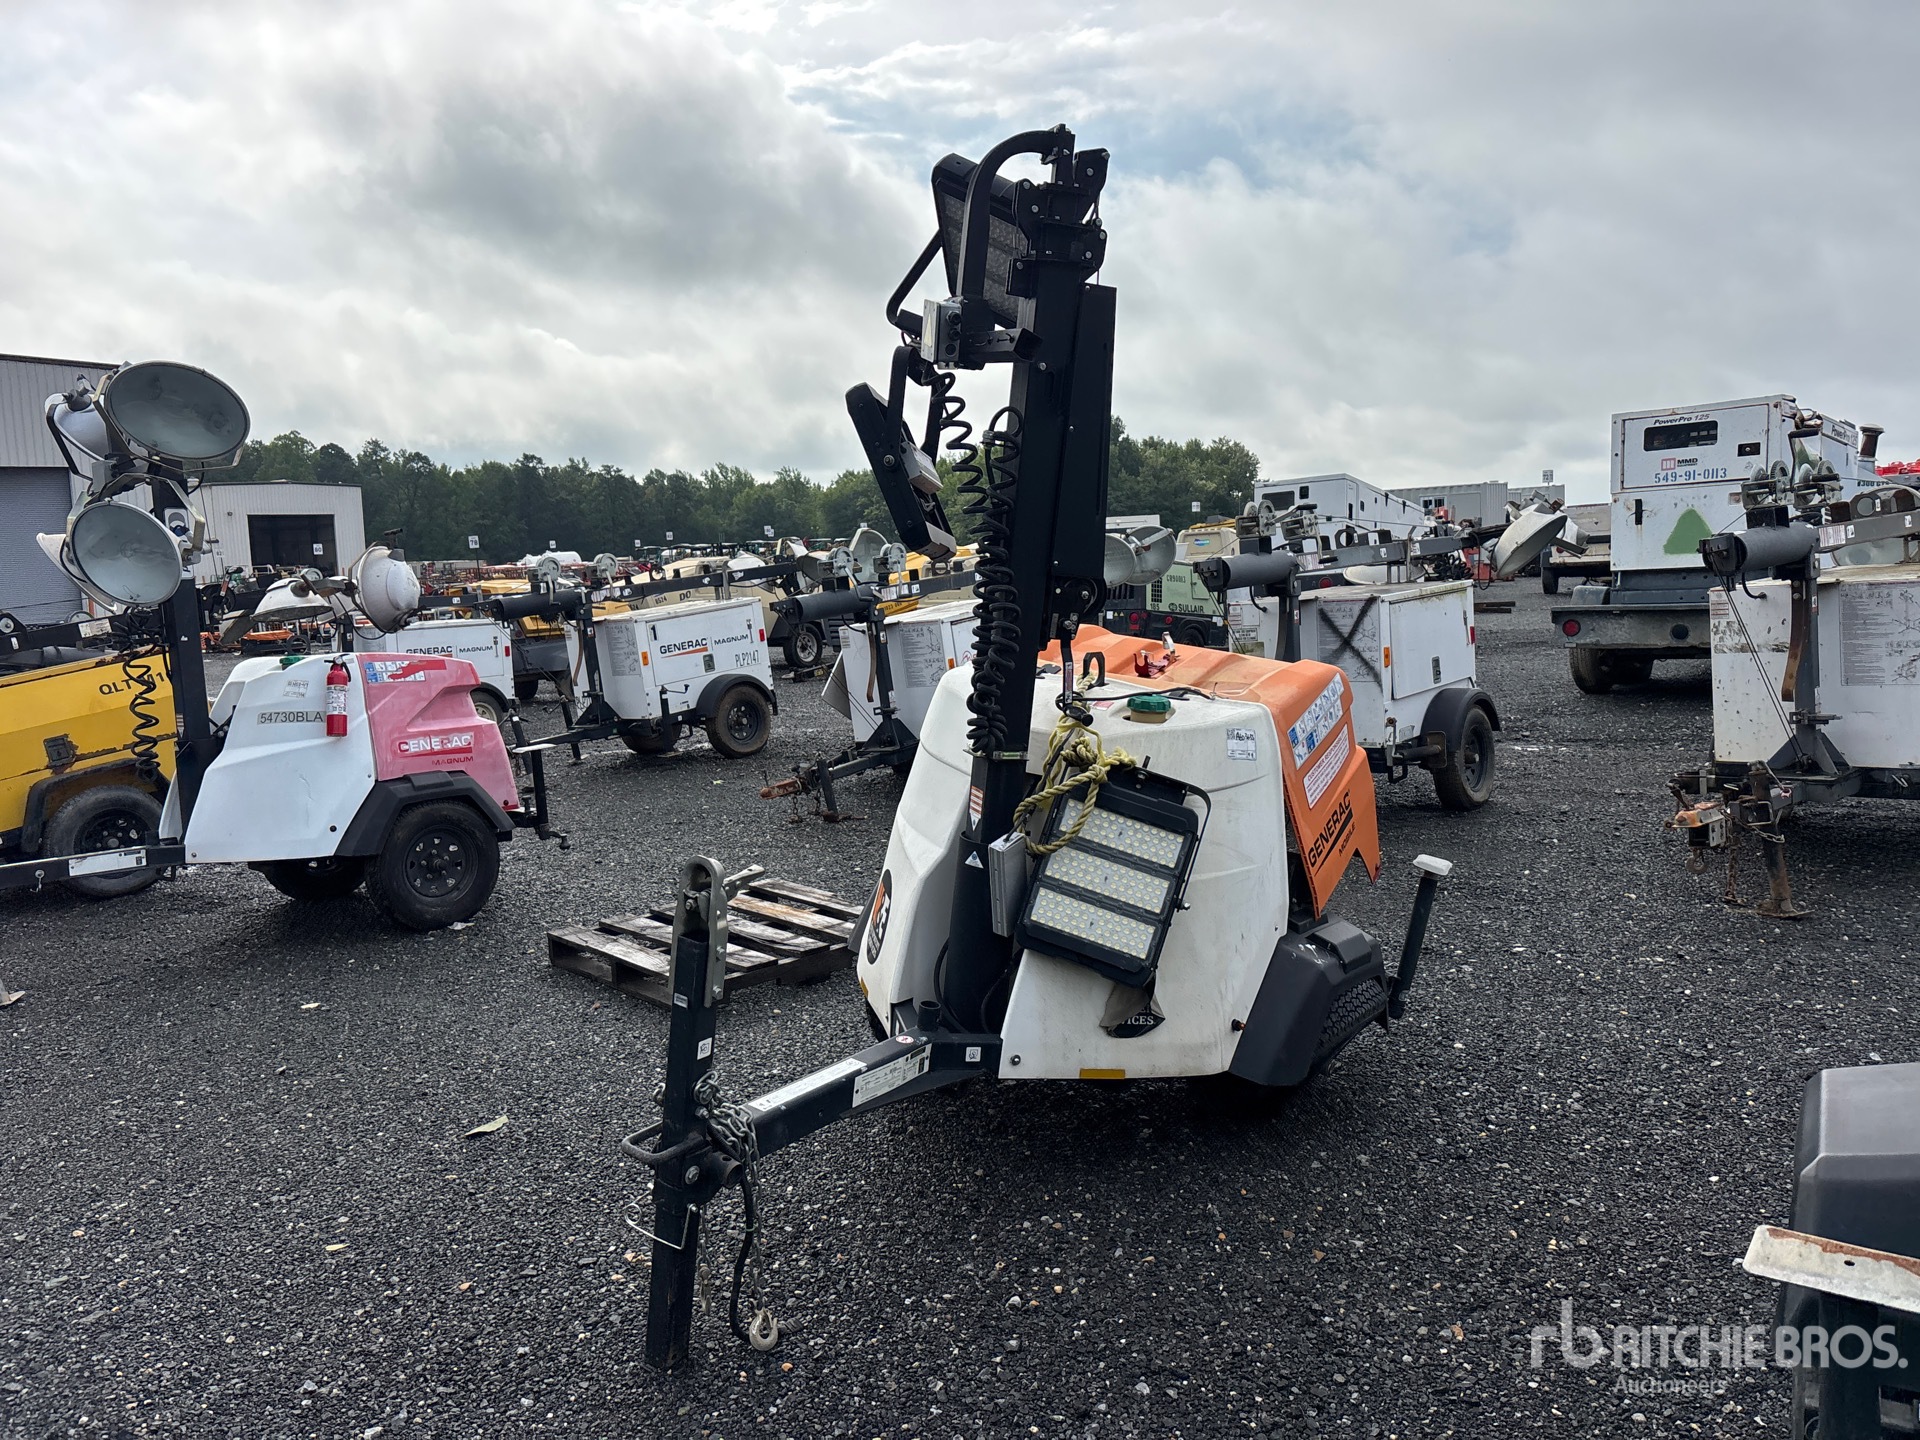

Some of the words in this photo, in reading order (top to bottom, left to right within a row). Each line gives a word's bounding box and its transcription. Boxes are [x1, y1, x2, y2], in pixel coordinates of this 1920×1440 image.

[1653, 416, 1693, 425] PowerPro
[1694, 413, 1710, 421] 125
[1654, 467, 1727, 484] 549-91-0113
[1178, 604, 1204, 613] SULLAIR
[650, 624, 658, 640] 1
[406, 645, 453, 655] GENERAC
[458, 645, 494, 654] MAGNUM
[660, 637, 708, 655] GENERAC
[713, 633, 749, 646] MAGNUM
[734, 650, 760, 668] PLP2147
[260, 710, 324, 725] 54730BLA
[397, 734, 473, 753] GENERAC
[432, 755, 474, 766] MAGNUM
[1307, 789, 1351, 869] GENERAC
[1338, 821, 1356, 857] MOBILE
